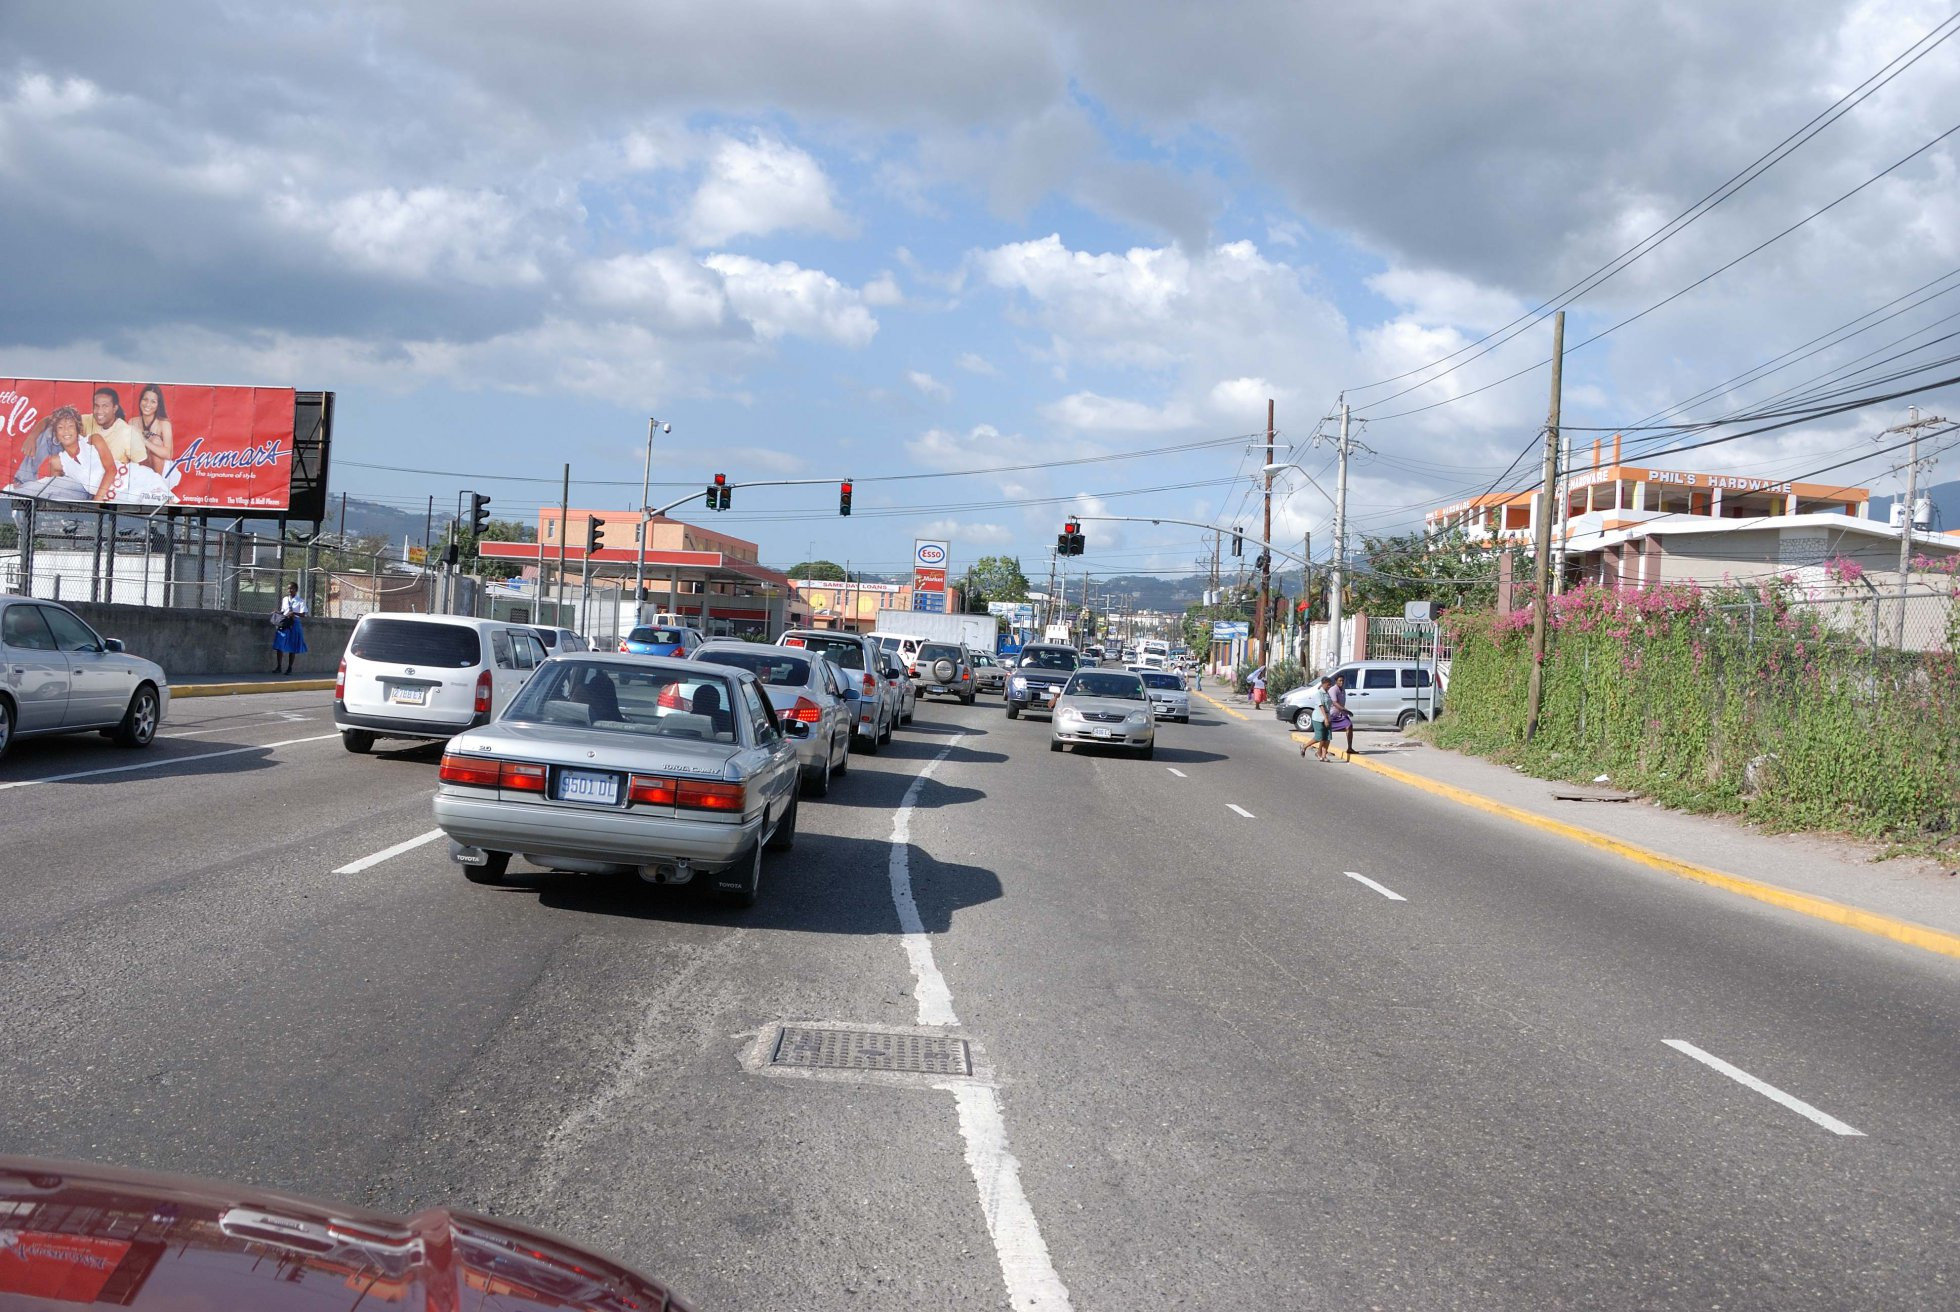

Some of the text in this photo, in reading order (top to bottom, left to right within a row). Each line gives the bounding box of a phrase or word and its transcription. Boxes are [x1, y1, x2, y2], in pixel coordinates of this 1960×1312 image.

[165, 437, 292, 479] Ammar's
[207, 471, 234, 479] signature
[242, 472, 257, 480] style
[1648, 470, 1792, 493] PHIL'S HARDWARE
[922, 549, 941, 558] Esso
[922, 575, 943, 583] Market
[457, 854, 480, 862] TOYOTA
[719, 881, 742, 889] TOYOTA
